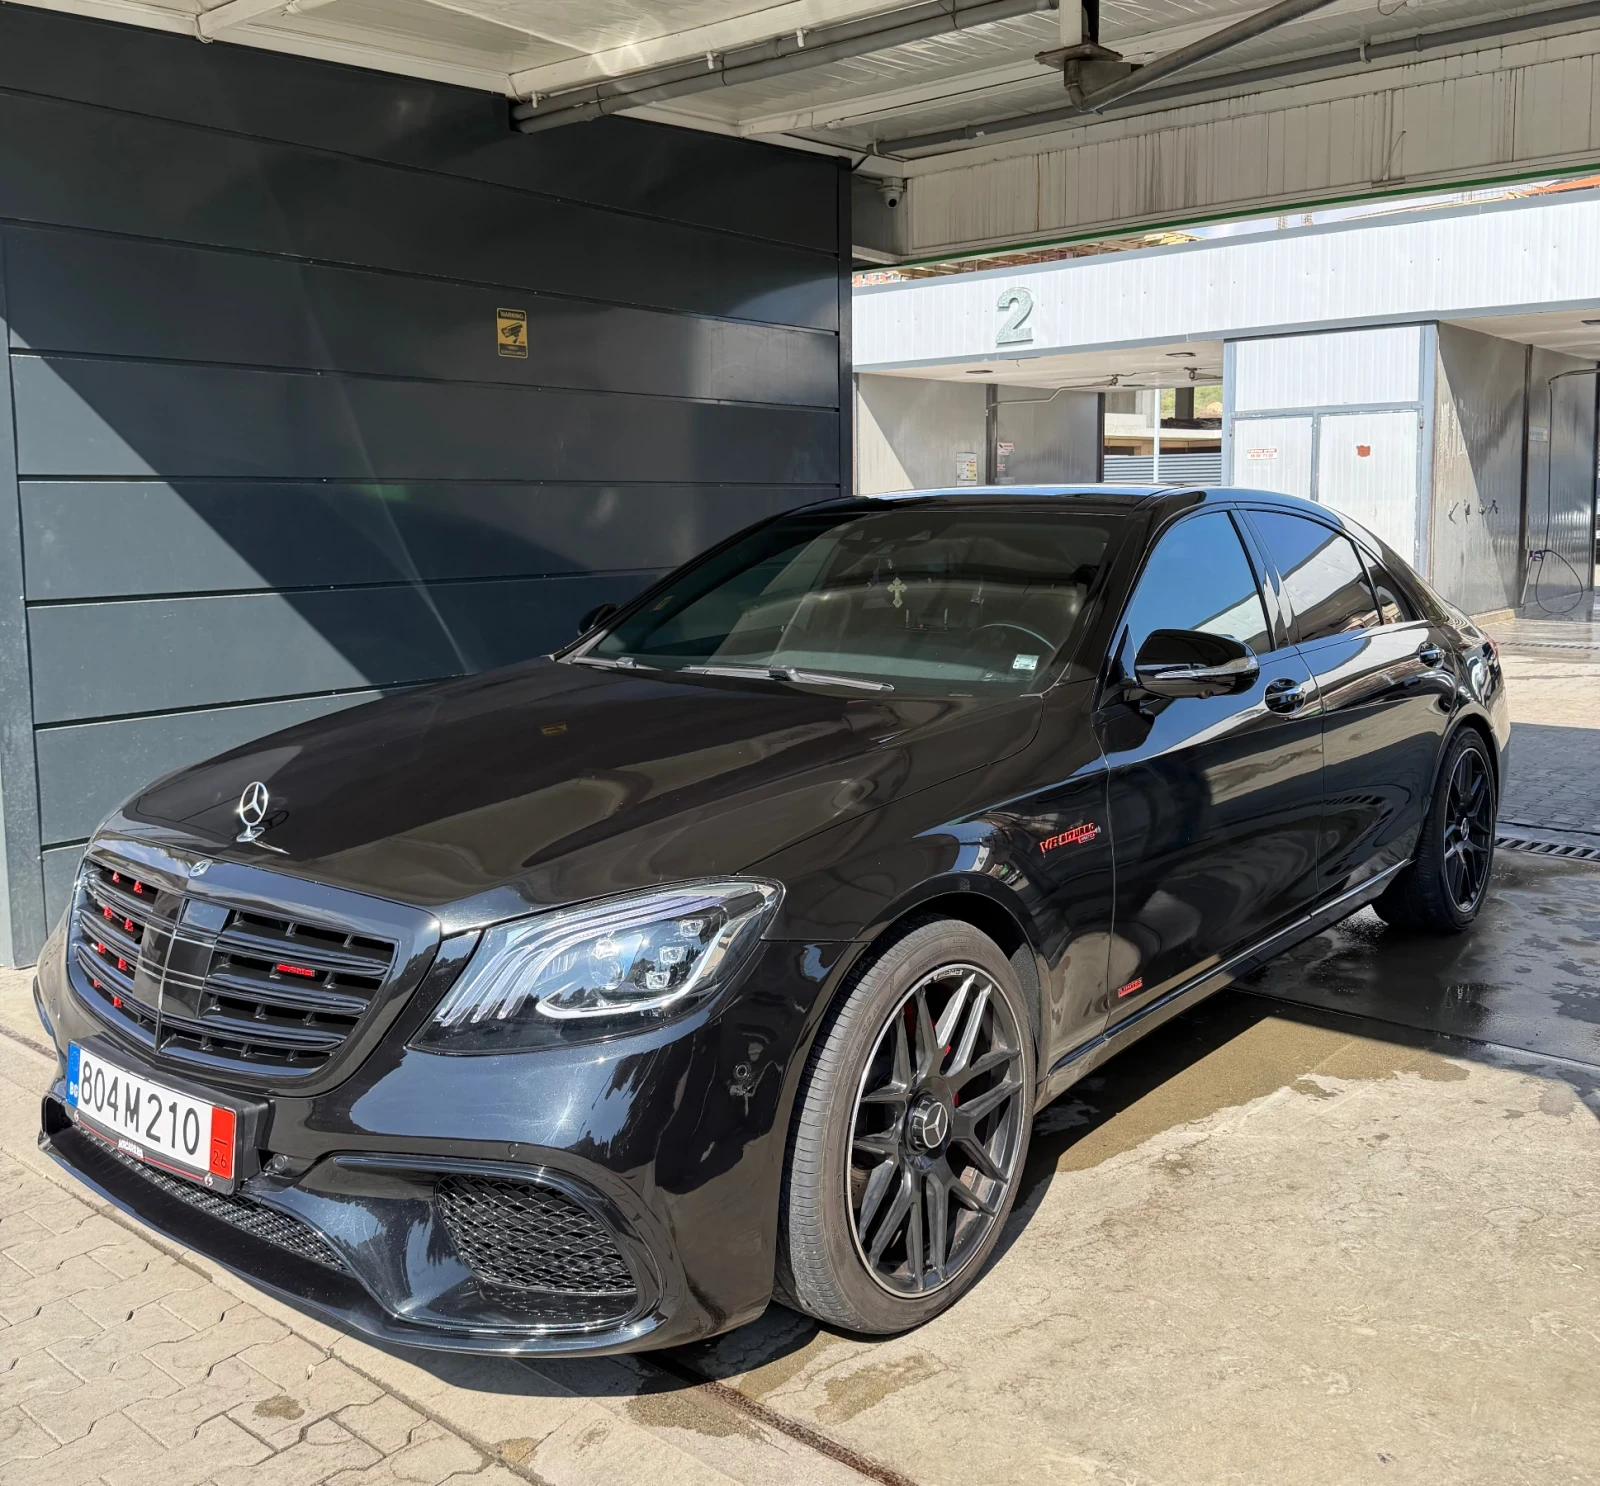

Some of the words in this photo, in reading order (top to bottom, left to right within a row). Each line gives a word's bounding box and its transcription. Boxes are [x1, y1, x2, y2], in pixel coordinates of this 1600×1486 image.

[500, 310, 524, 320] WARNING
[996, 287, 1034, 347] 2
[69, 1080, 79, 1098] BG
[81, 1061, 200, 1156] 804M210
[212, 1150, 227, 1168] 26
